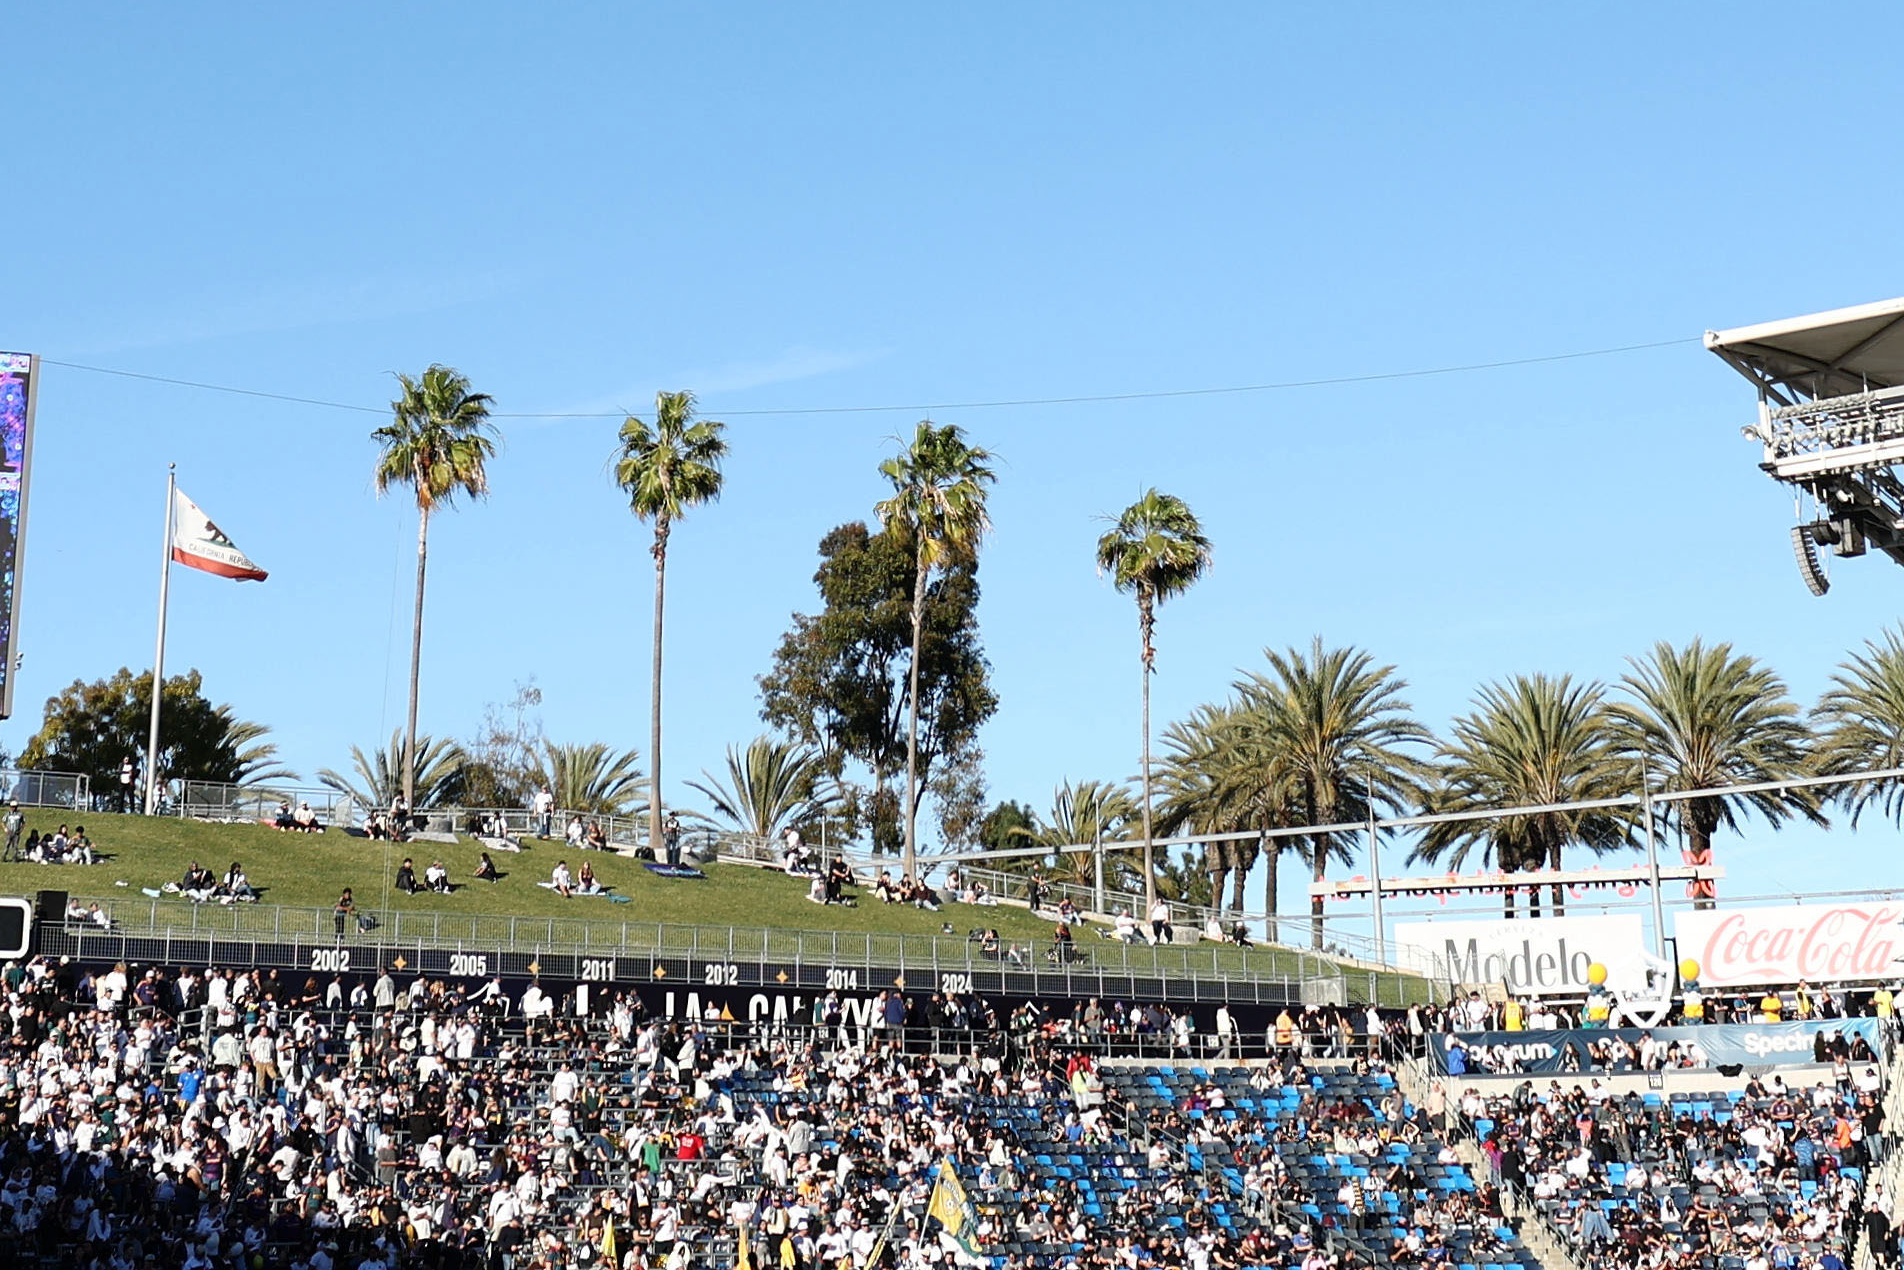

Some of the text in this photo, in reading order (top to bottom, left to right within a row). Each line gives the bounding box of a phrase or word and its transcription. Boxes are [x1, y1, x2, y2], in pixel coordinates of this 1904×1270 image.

[311, 949, 974, 995] 2002 2005 2011 2012 2014 2024
[1445, 938, 1593, 988] Modelo
[1744, 1031, 1835, 1058] Spectr
